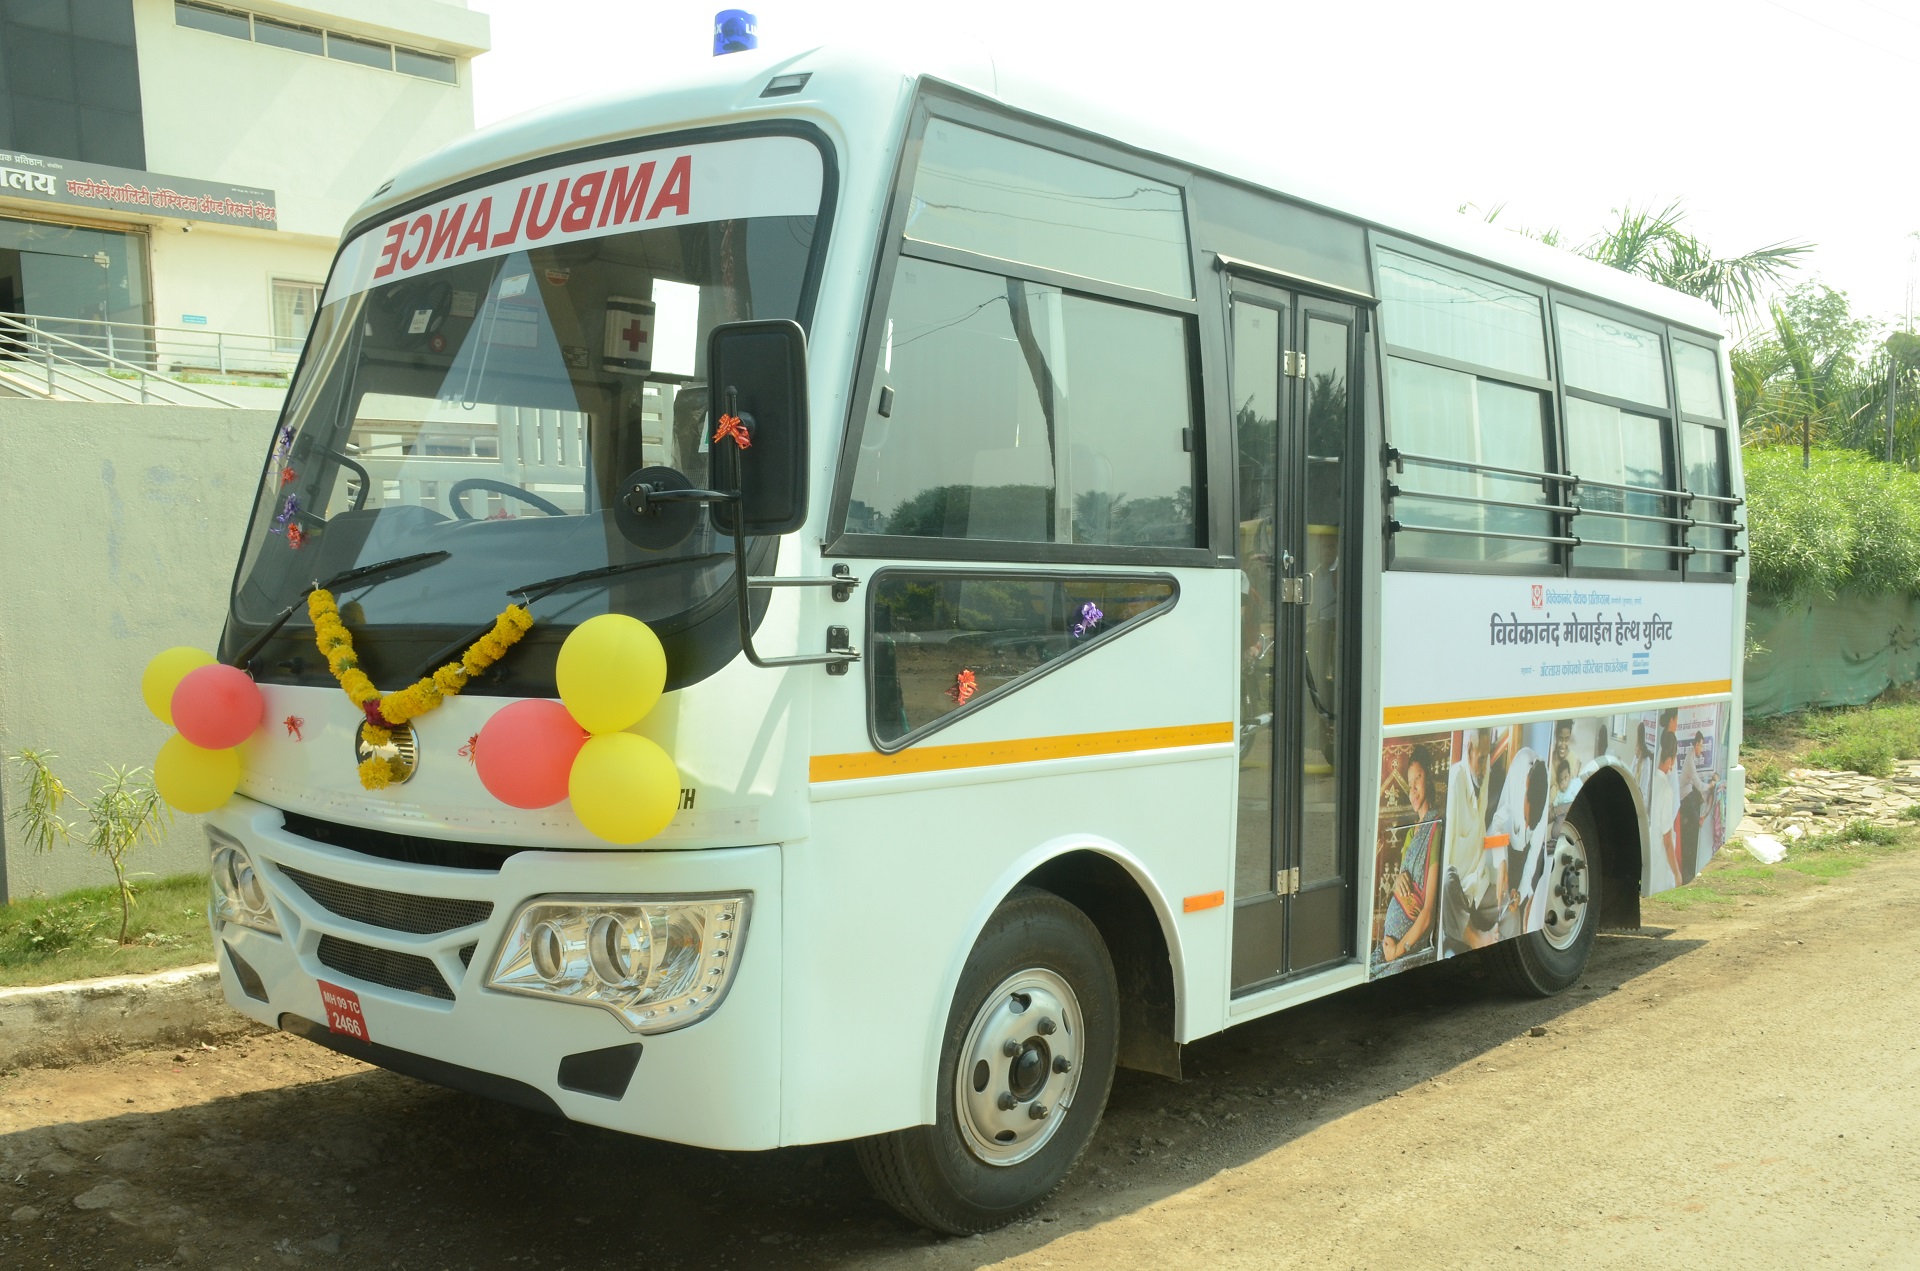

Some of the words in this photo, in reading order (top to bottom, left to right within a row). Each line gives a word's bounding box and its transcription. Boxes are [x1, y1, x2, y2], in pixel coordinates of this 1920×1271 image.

[1490, 612, 1560, 647] विवेकानंद
[1563, 612, 1612, 646] मोबाईल
[1615, 612, 1640, 646] हेल्थ
[1643, 612, 1673, 650] युनिट
[323, 990, 337, 1006] MH
[337, 996, 347, 1010] 09
[347, 1000, 360, 1014] TC
[333, 1011, 361, 1037] 2466
